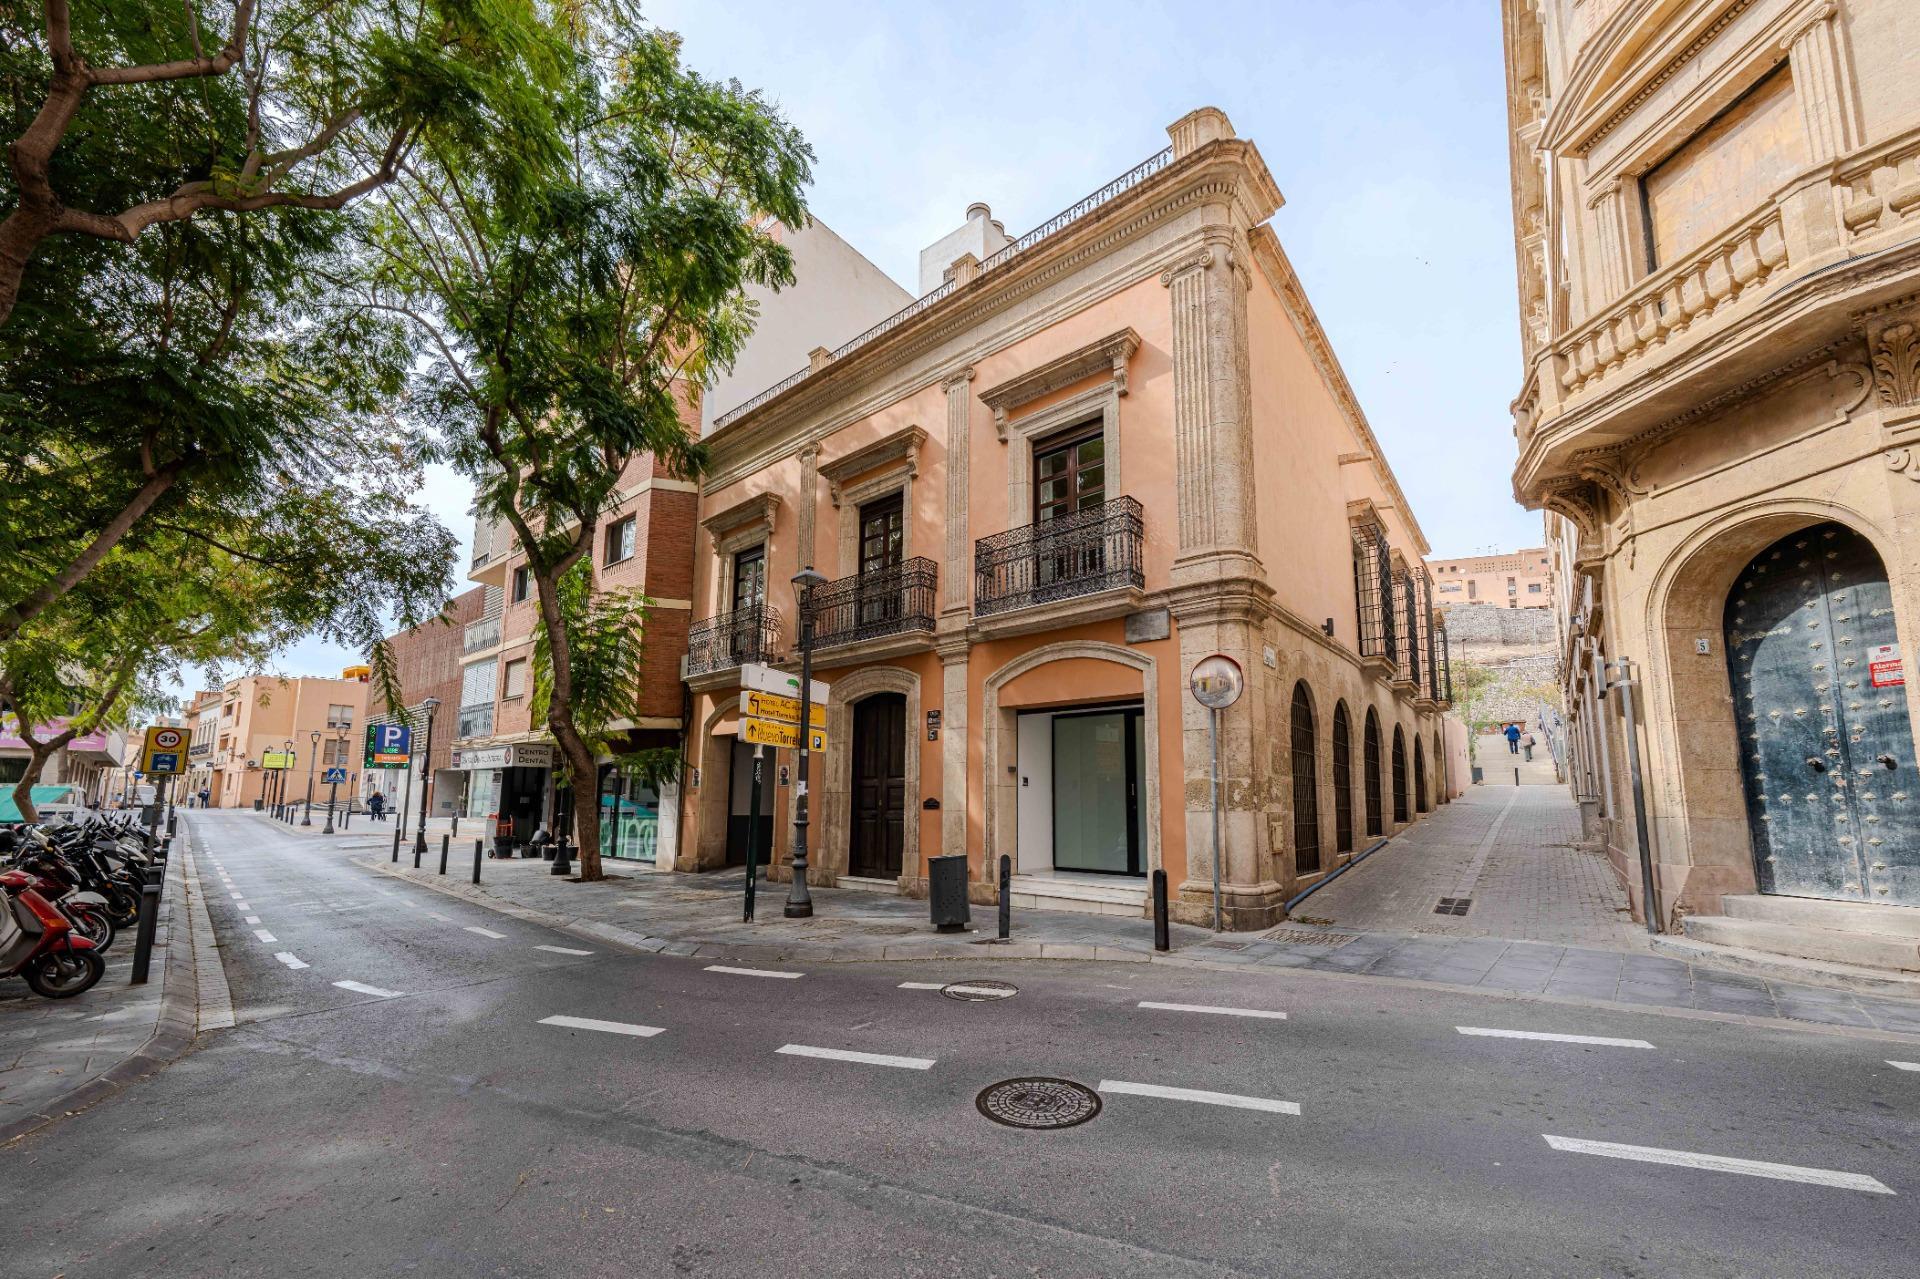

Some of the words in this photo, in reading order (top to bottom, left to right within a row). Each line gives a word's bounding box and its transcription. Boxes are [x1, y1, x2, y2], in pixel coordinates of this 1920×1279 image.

[1699, 641, 1706, 652] 5
[160, 735, 177, 743] 30
[385, 726, 402, 747] P
[814, 736, 821, 748] P
[518, 748, 549, 756] CENTRO
[518, 757, 547, 765] DENTAL
